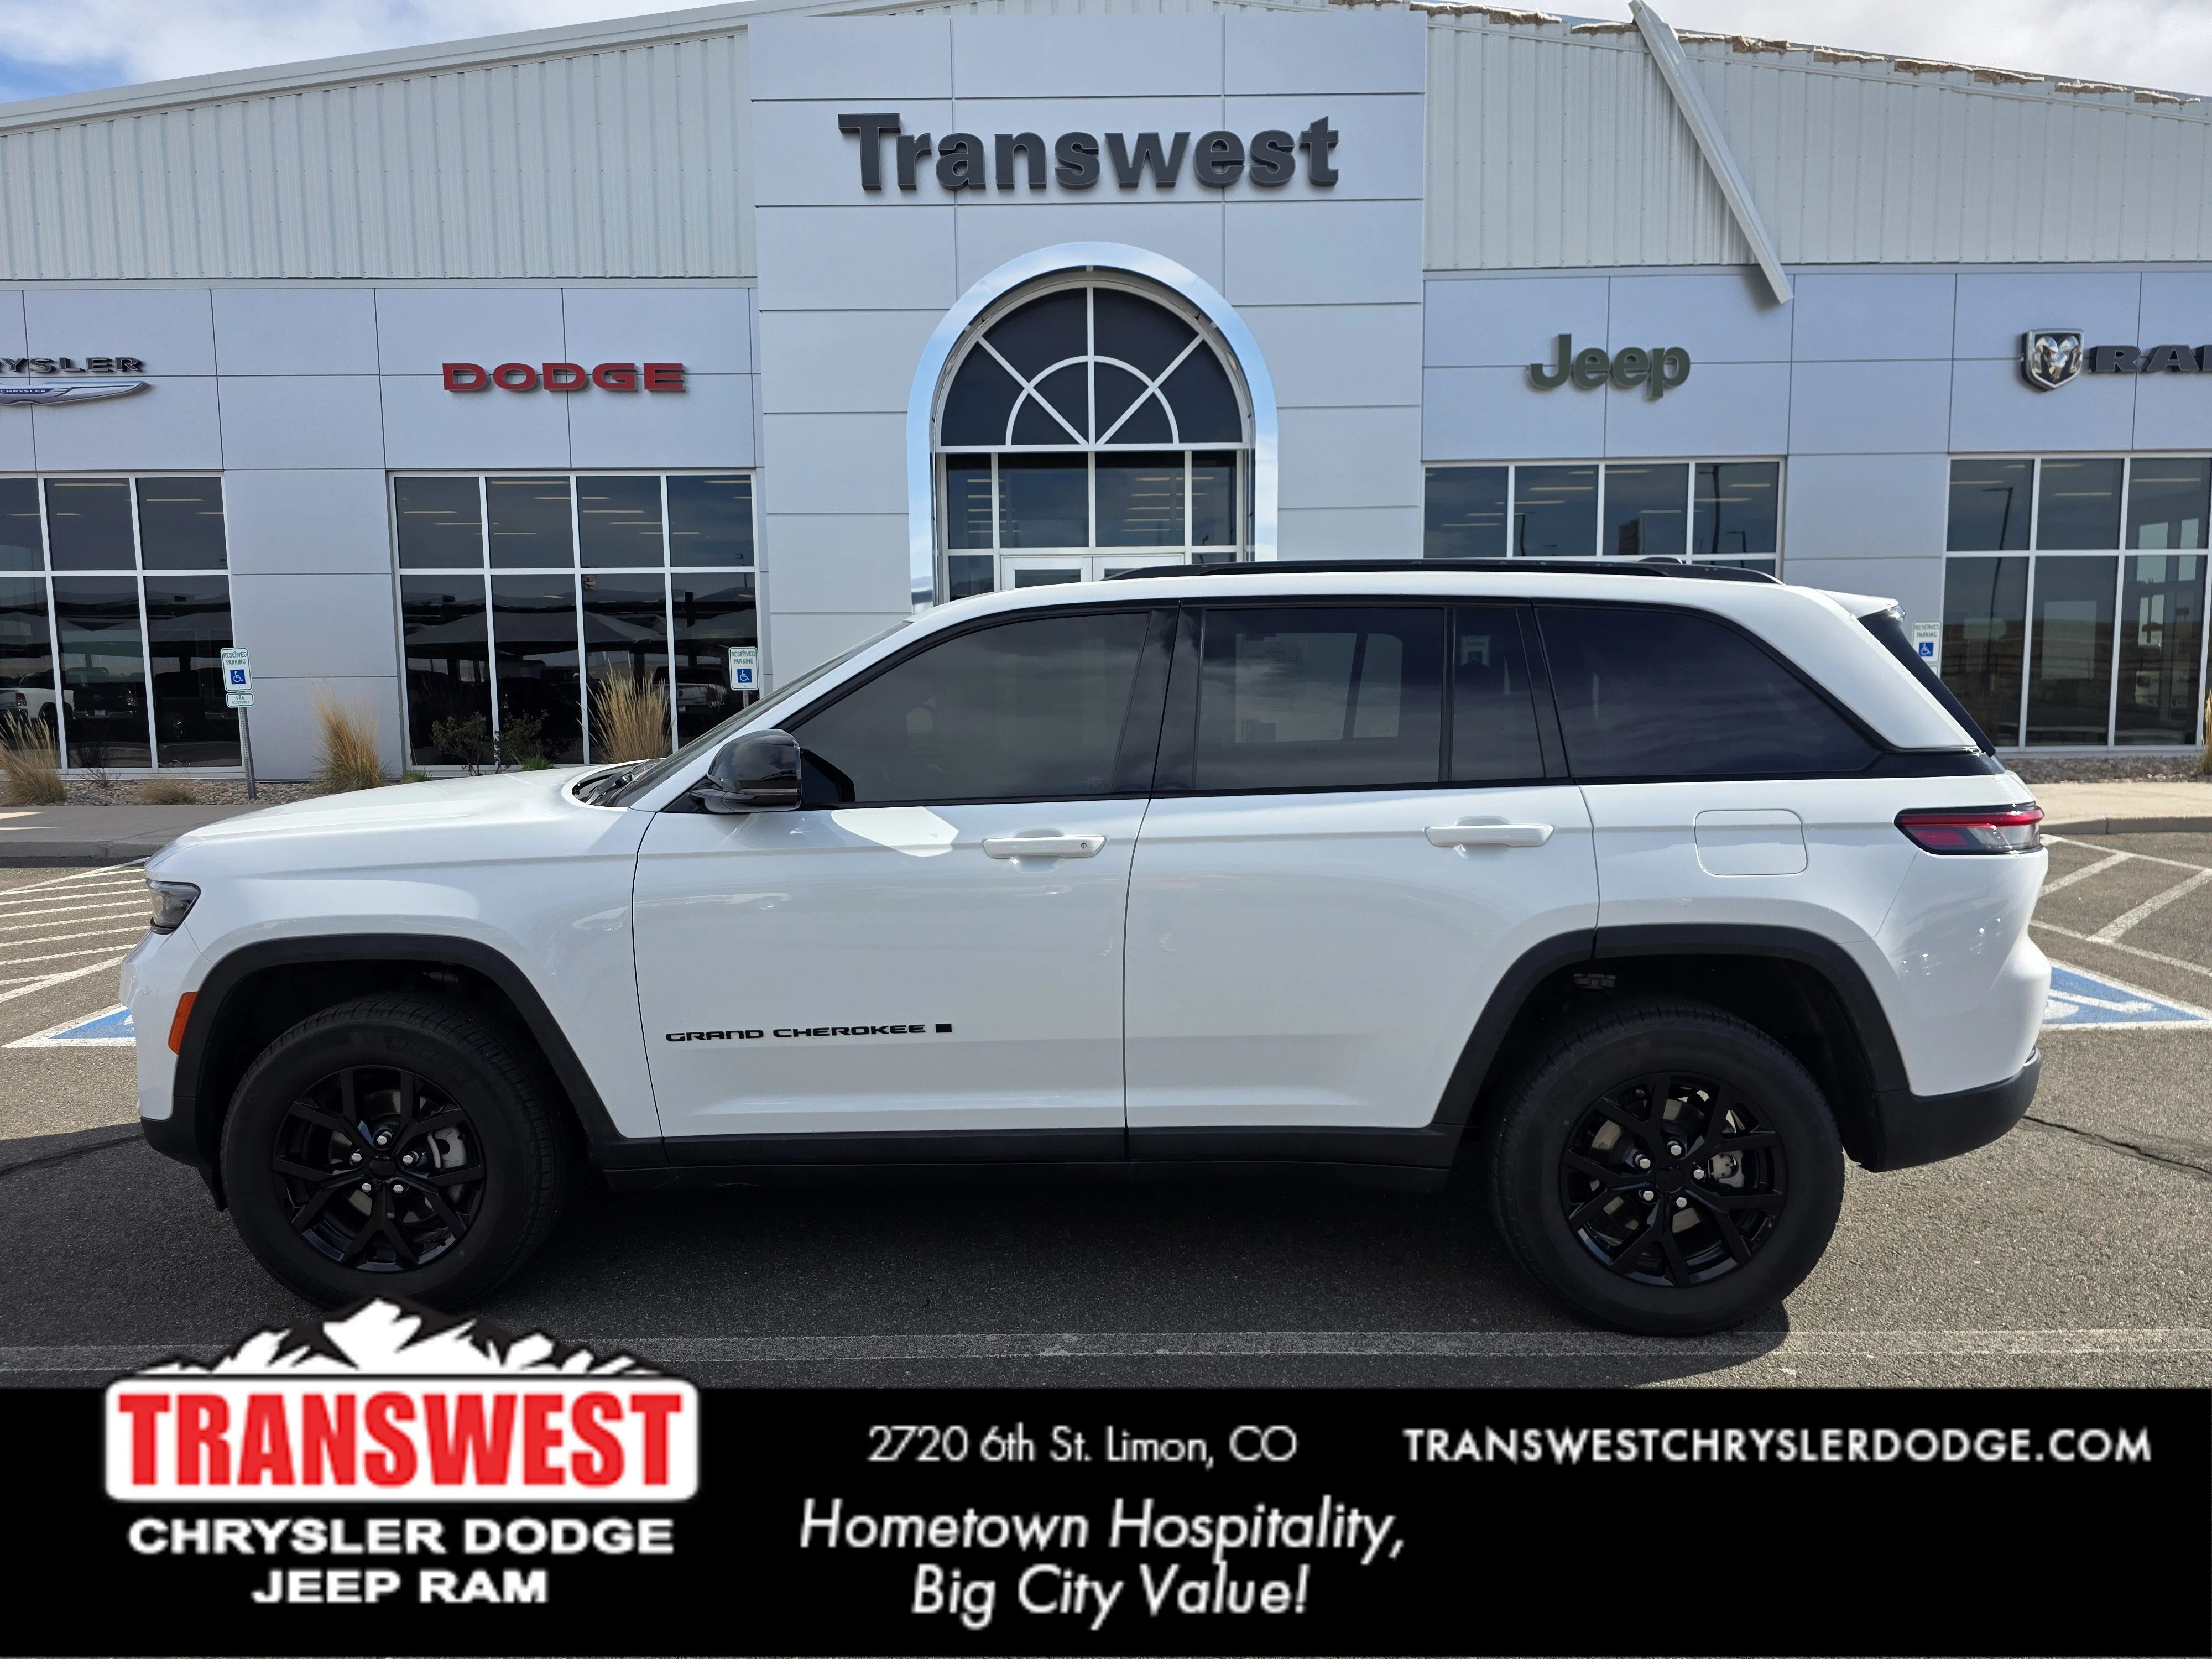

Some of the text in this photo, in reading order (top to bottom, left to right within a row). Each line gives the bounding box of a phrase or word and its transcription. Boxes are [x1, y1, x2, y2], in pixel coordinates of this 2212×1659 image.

[838, 113, 1339, 191] Transwest
[0, 357, 140, 373] YSLER
[1527, 333, 1691, 398] Jeep
[2089, 345, 2212, 372] RA
[442, 363, 686, 392] DODGE
[665, 1024, 926, 1042] GRAND CHEROKEE
